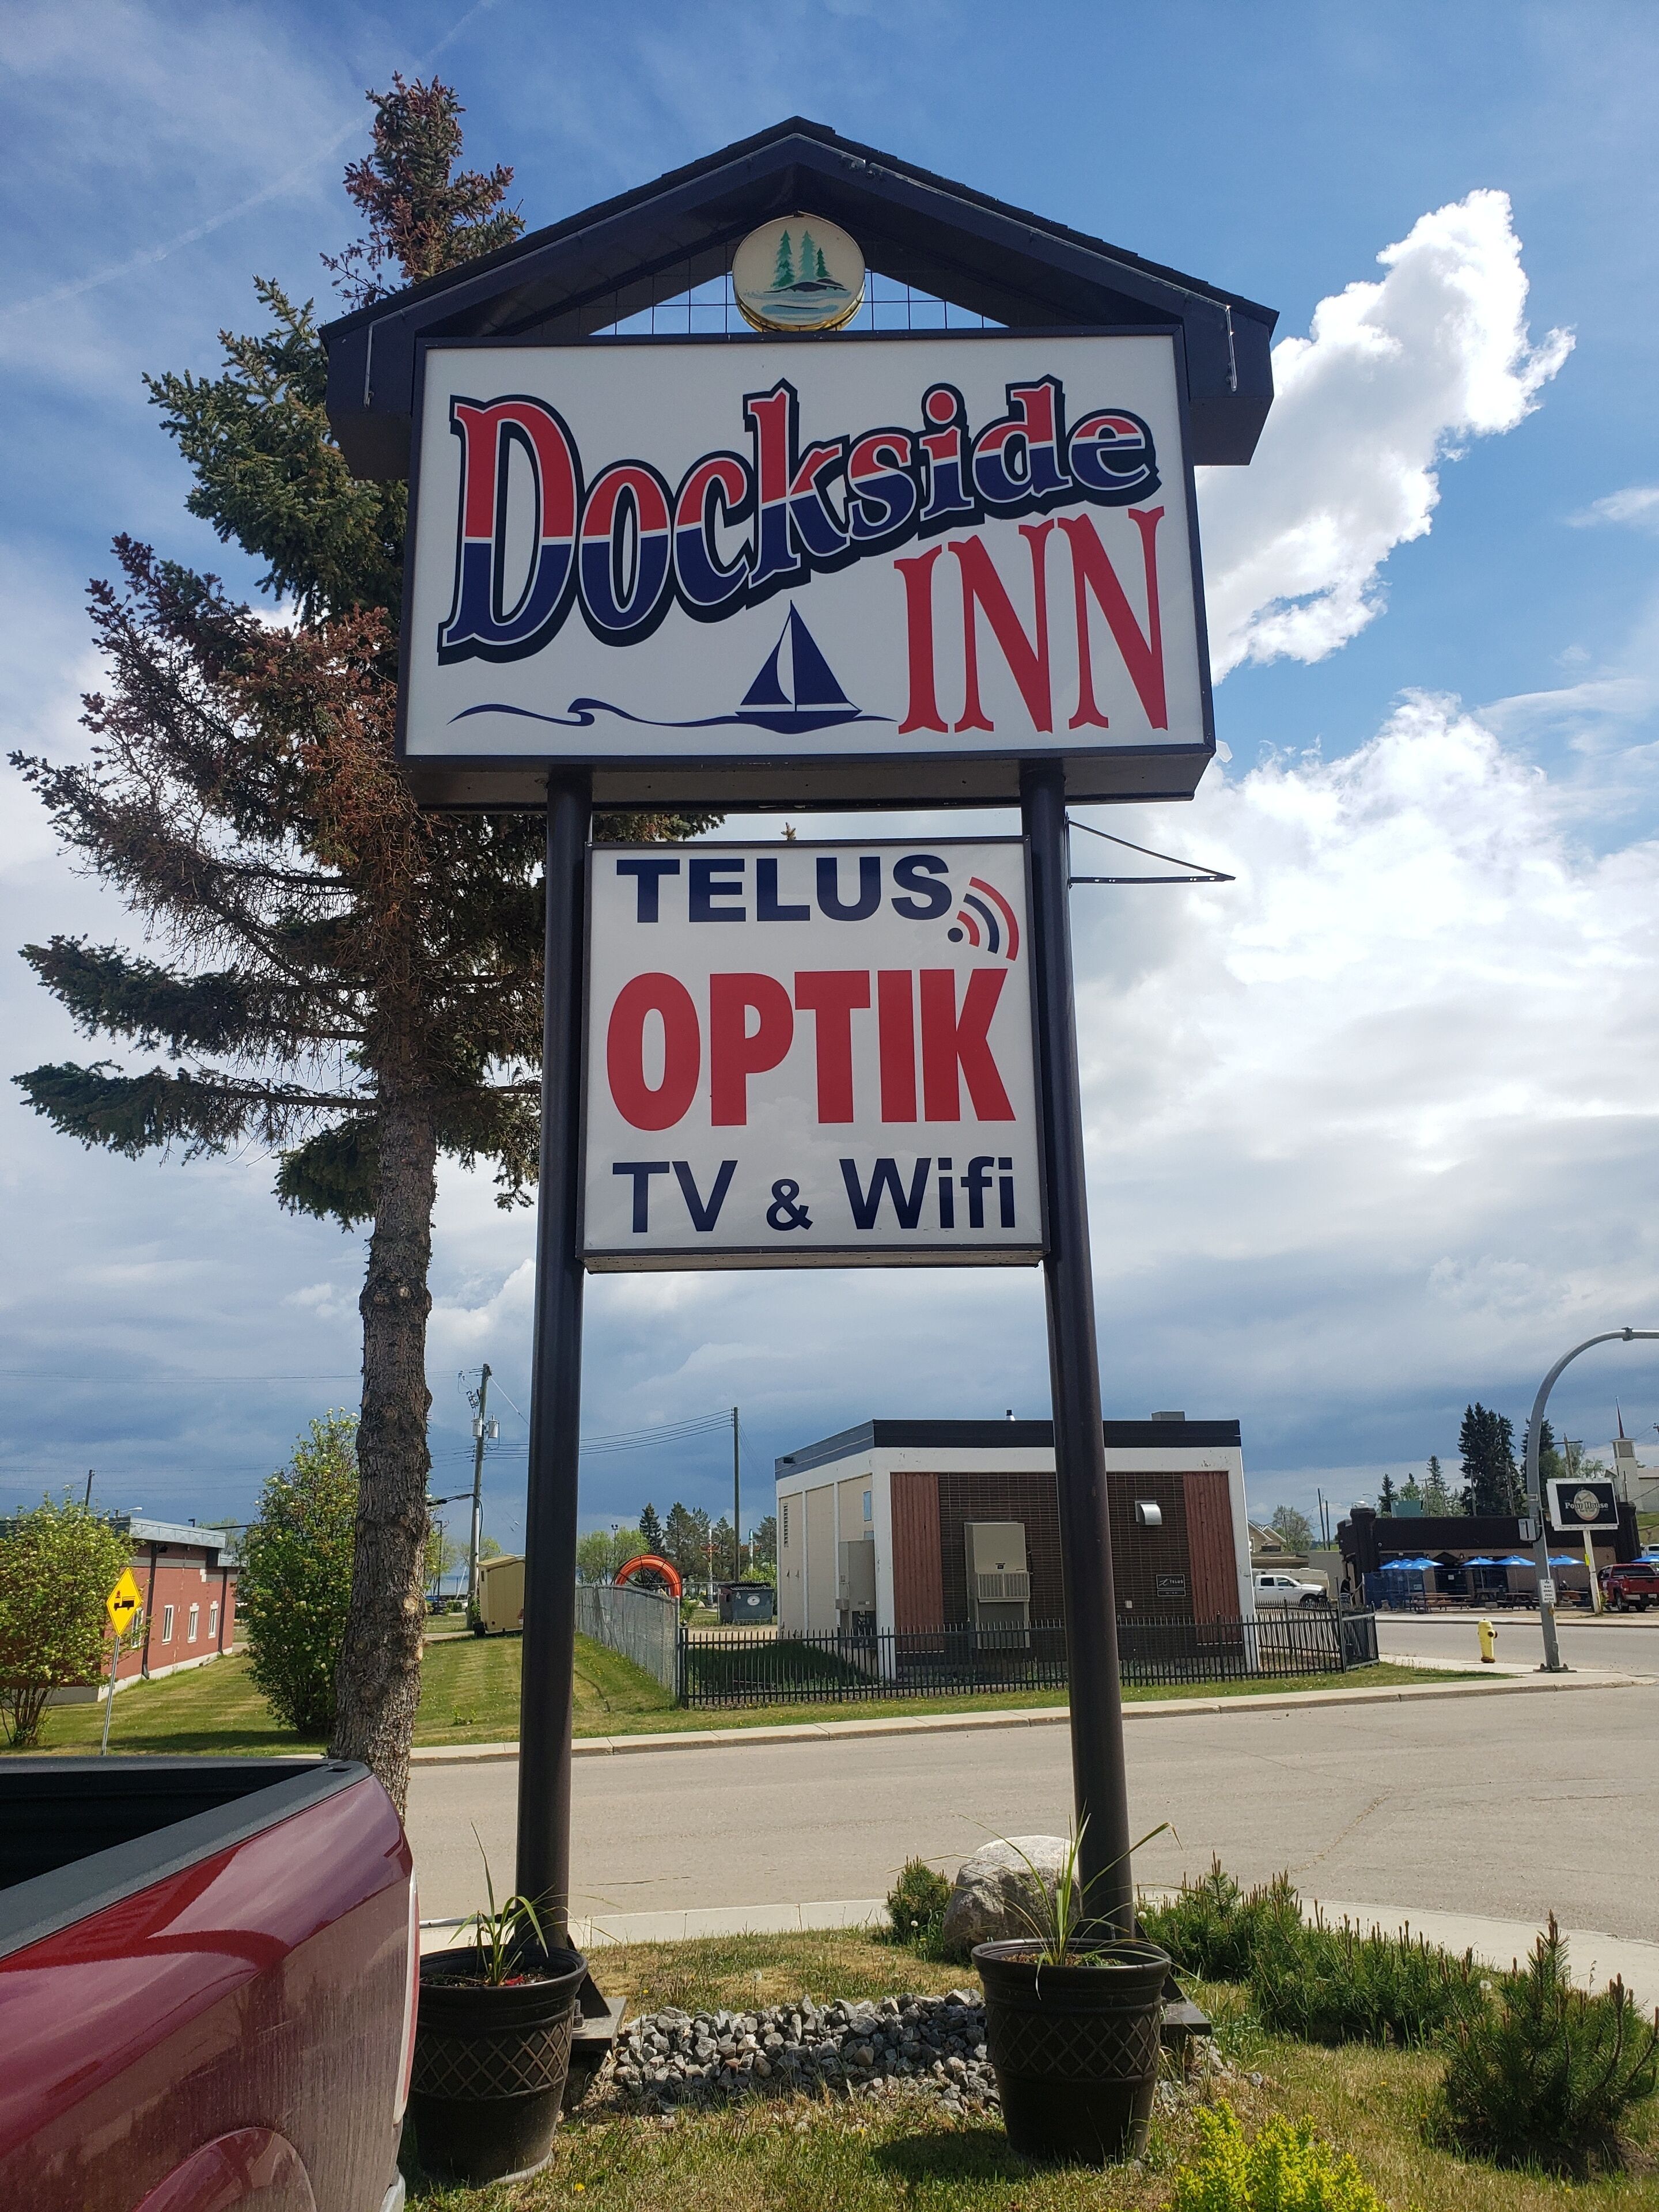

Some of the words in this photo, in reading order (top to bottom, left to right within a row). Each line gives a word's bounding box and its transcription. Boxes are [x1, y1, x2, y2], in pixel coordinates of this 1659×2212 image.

[438, 374, 1161, 666] Dockside
[895, 506, 1168, 734] INN
[616, 854, 952, 923] TELUS
[607, 968, 1016, 1131] OPTIK
[612, 1160, 738, 1233] TV
[766, 1179, 813, 1232] &
[840, 1156, 1016, 1230] Wifi
